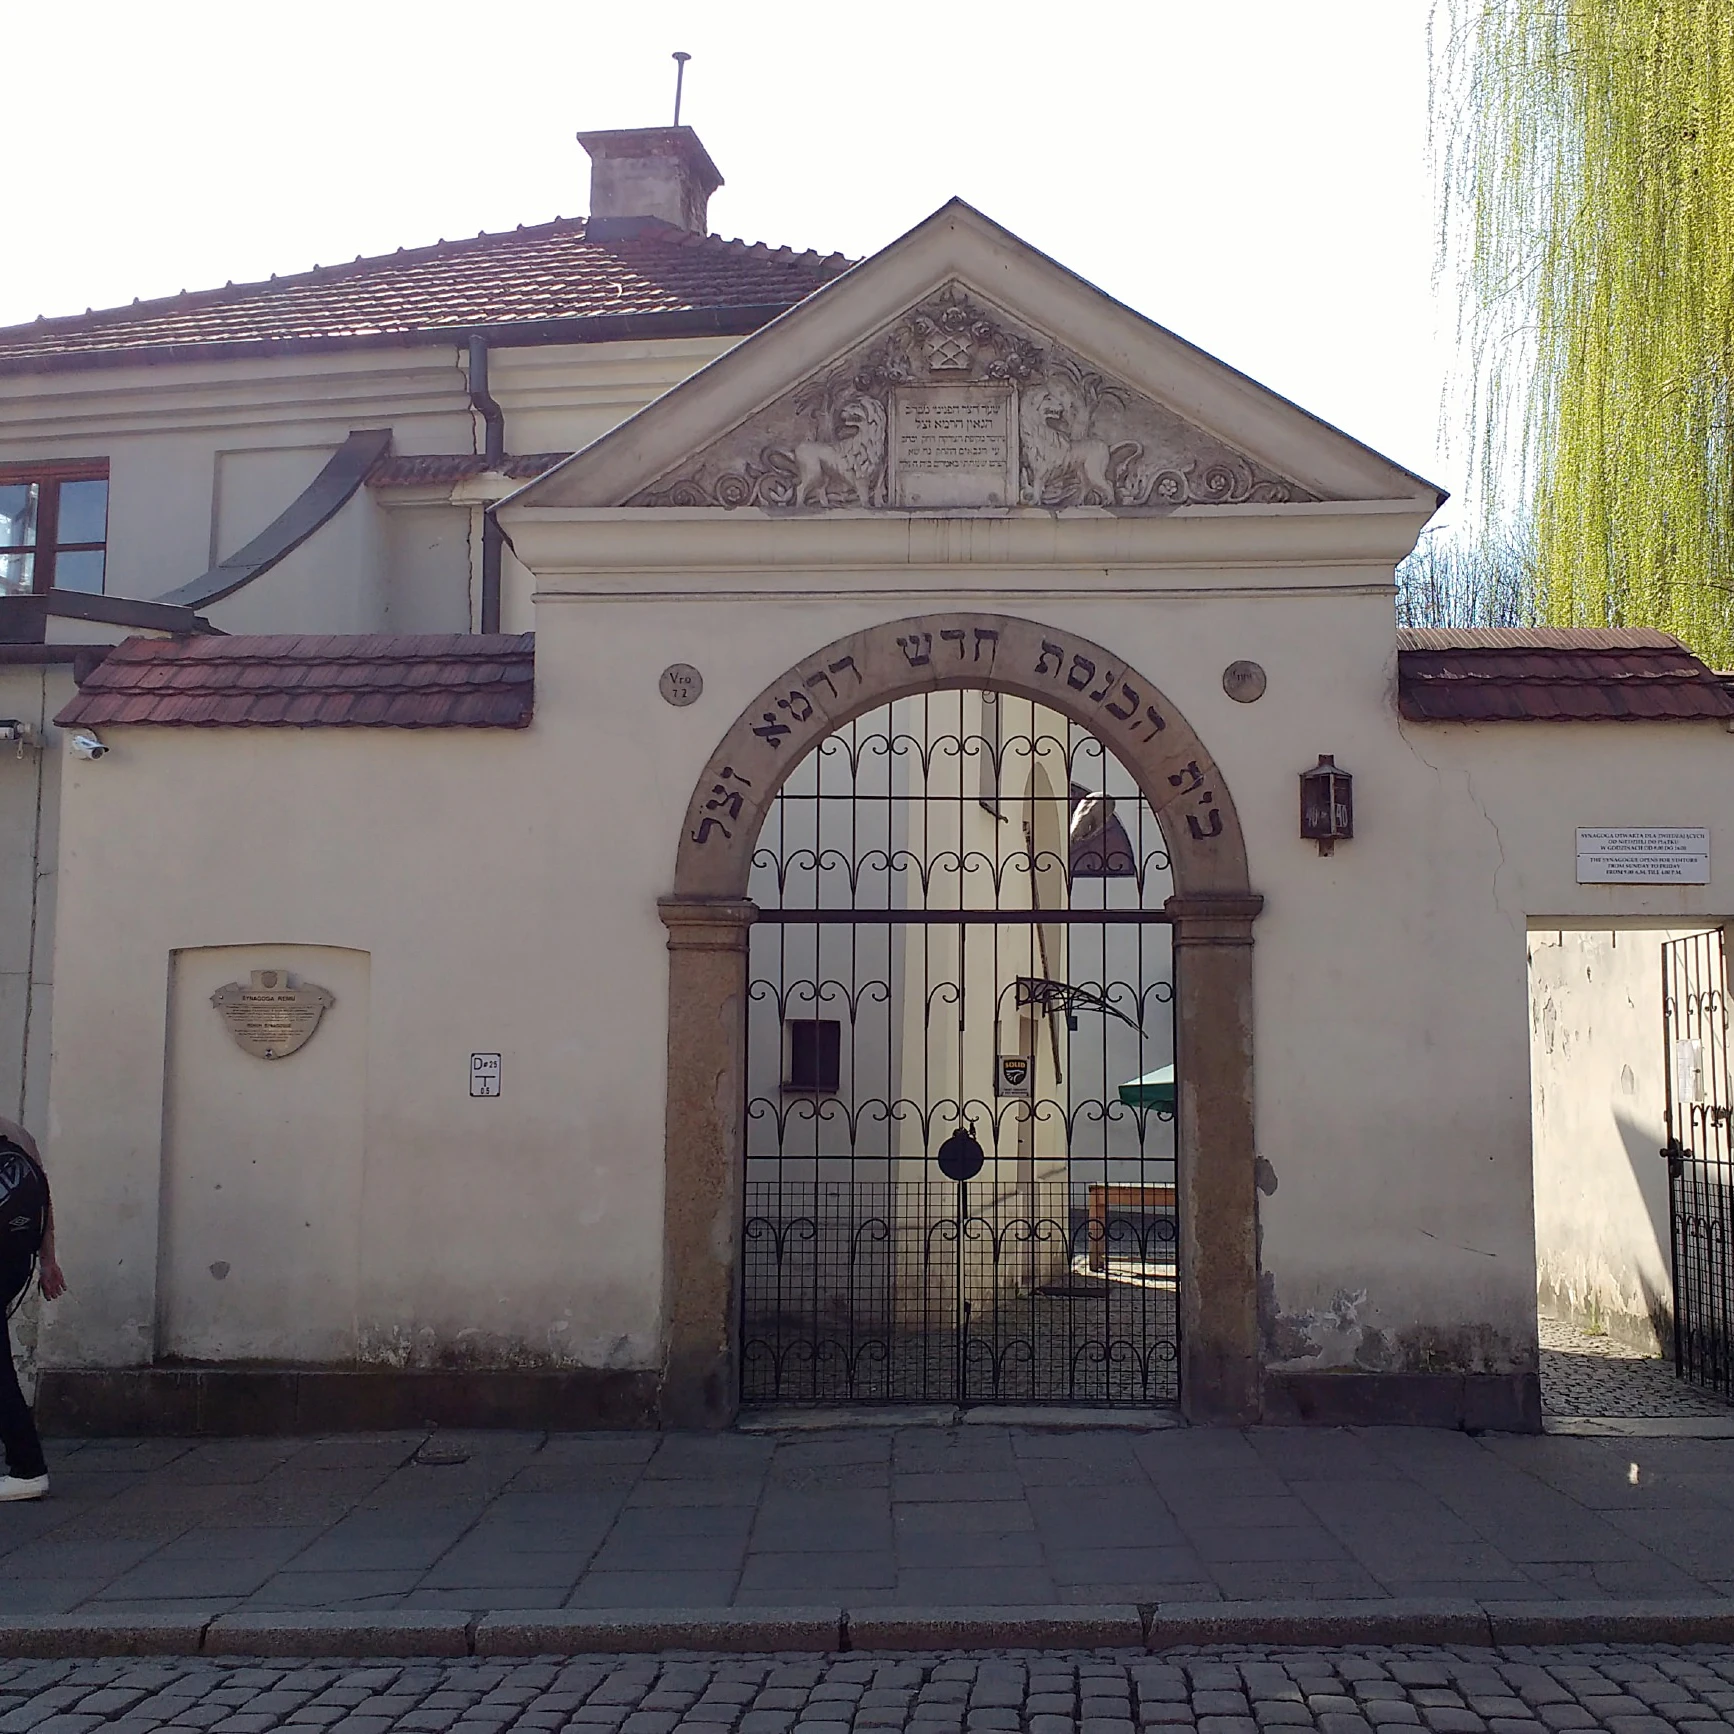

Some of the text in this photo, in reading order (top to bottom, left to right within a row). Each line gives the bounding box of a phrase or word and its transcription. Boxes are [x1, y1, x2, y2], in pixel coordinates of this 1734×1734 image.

[669, 672, 692, 684] Vro
[1035, 640, 1166, 743] הכנסת
[1168, 761, 1223, 840] בית
